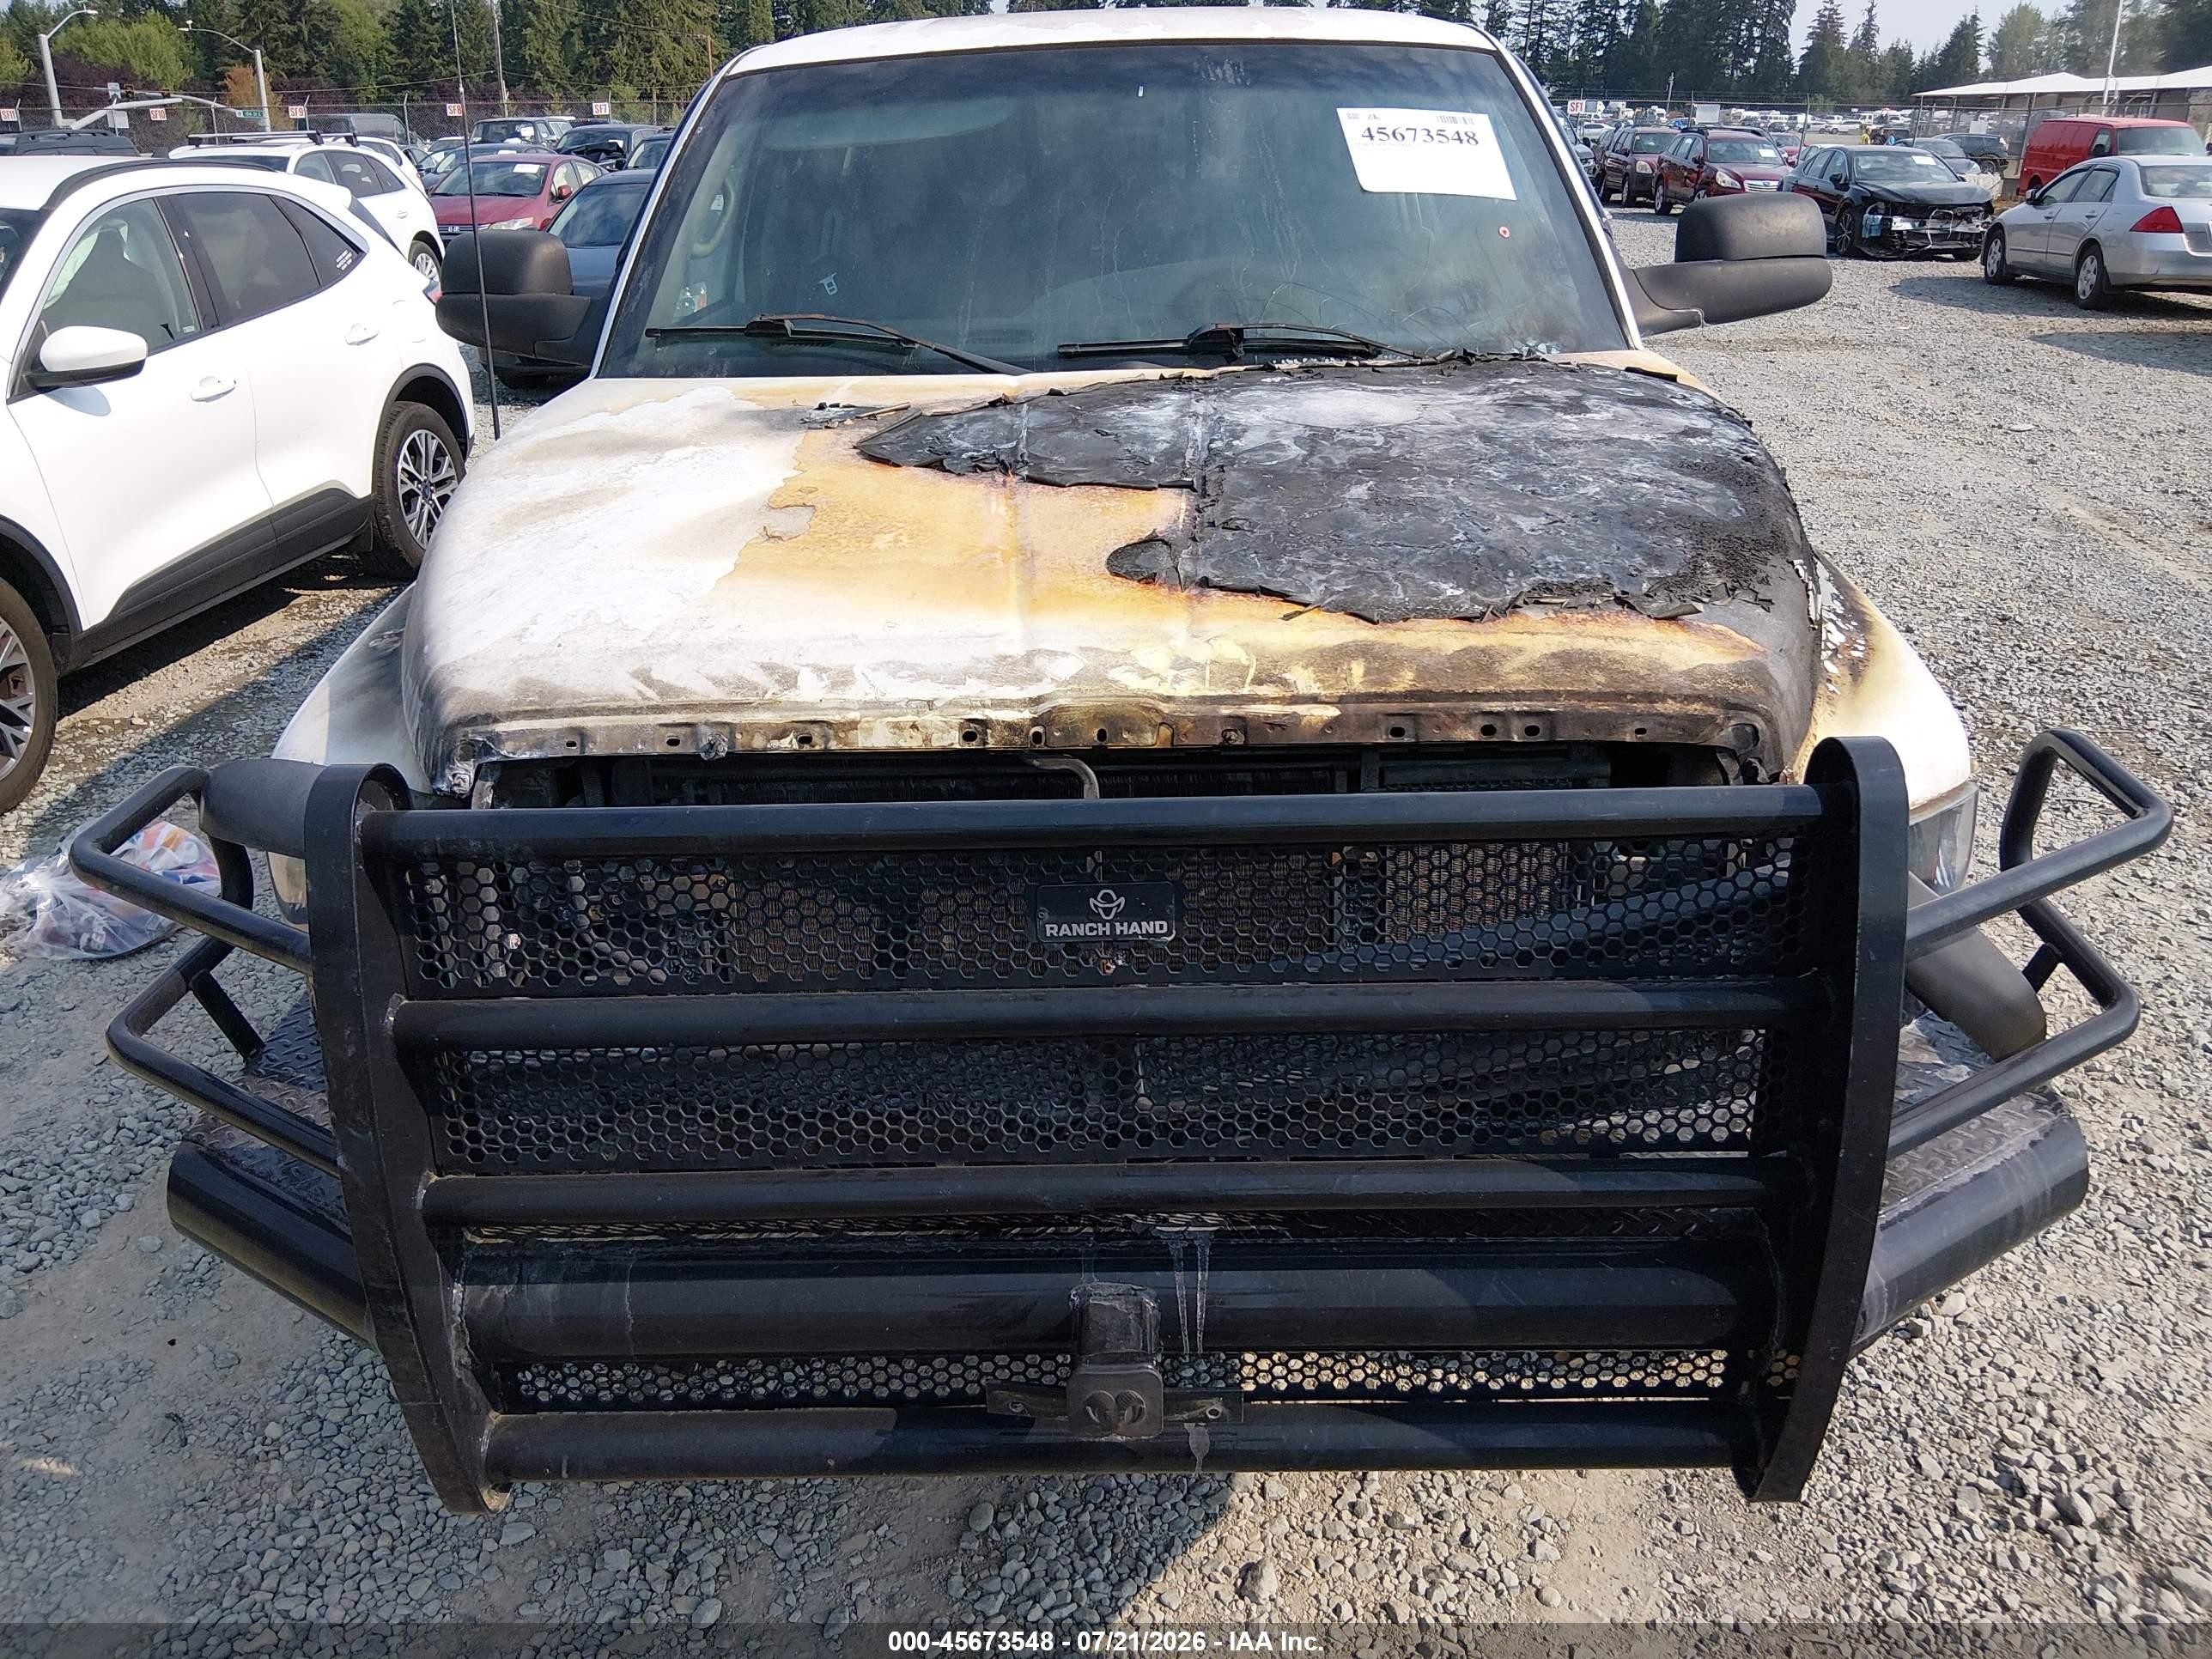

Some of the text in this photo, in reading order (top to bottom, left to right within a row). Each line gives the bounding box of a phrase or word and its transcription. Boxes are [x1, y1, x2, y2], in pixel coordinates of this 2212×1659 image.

[289, 106, 304, 117] SF9
[448, 105, 462, 115] SF8
[594, 104, 607, 113] SF7
[2, 110, 16, 120] SF11
[151, 109, 166, 119] SF10
[1361, 126, 1480, 145] 45673548
[1045, 921, 1168, 937] RANCH HAND
